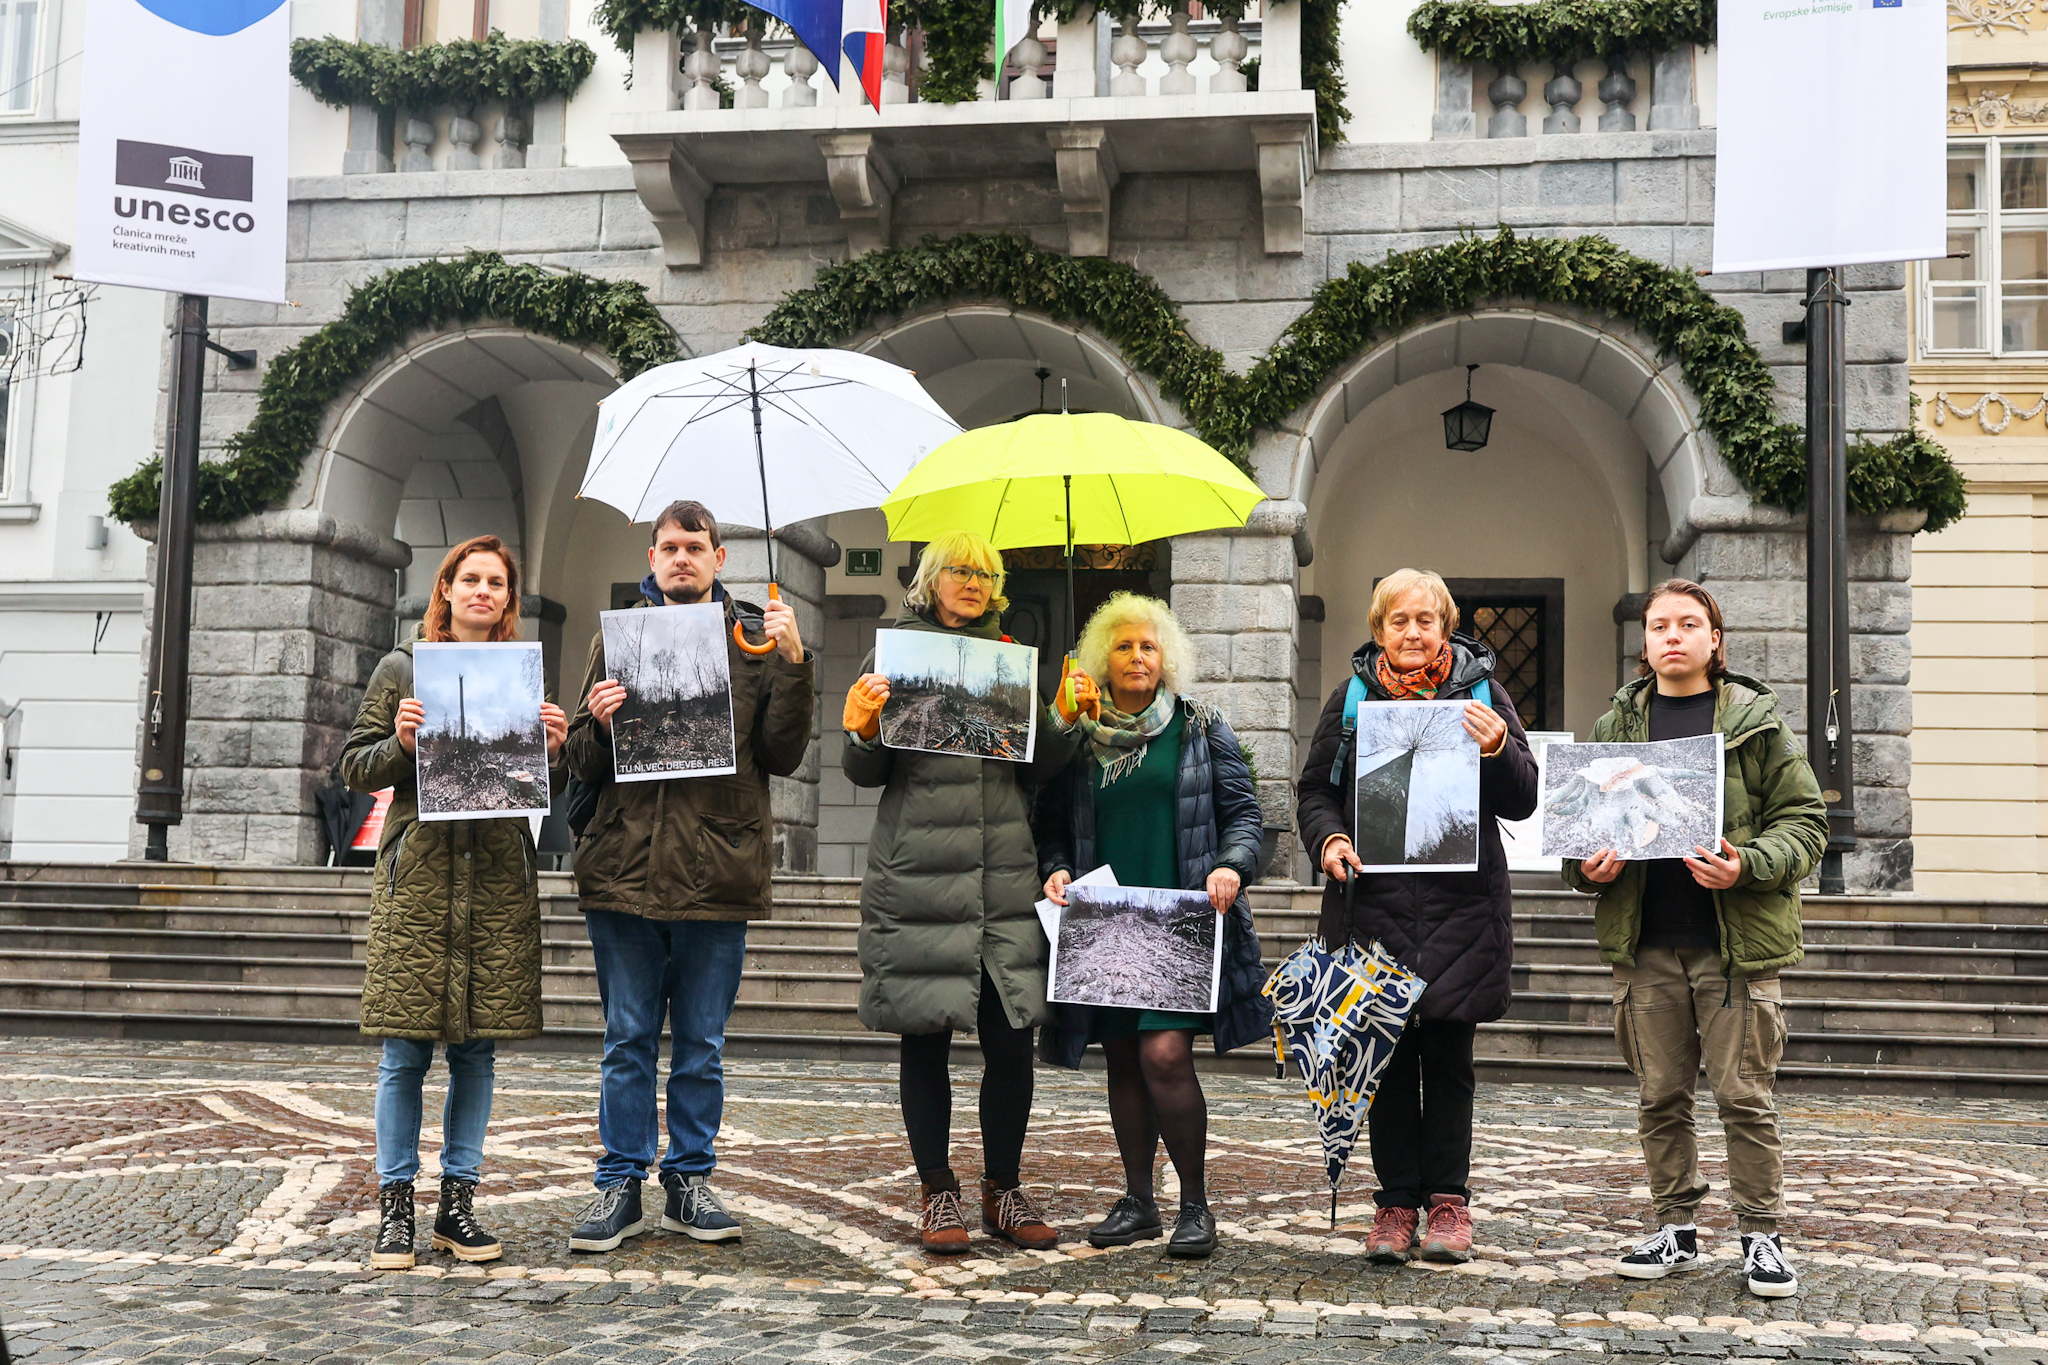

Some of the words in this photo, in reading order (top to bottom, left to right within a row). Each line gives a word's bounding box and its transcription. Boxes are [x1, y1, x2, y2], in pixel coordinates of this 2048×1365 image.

[1763, 7, 1809, 21] Evropske
[1812, 3, 1853, 15] komisije
[114, 196, 255, 233] unesco
[113, 225, 152, 240] Članica
[154, 231, 188, 244] mreže
[112, 239, 167, 255] kreativnih
[169, 247, 196, 259] mest
[862, 553, 867, 565] 1
[619, 764, 632, 773] TU
[634, 764, 644, 772] NI
